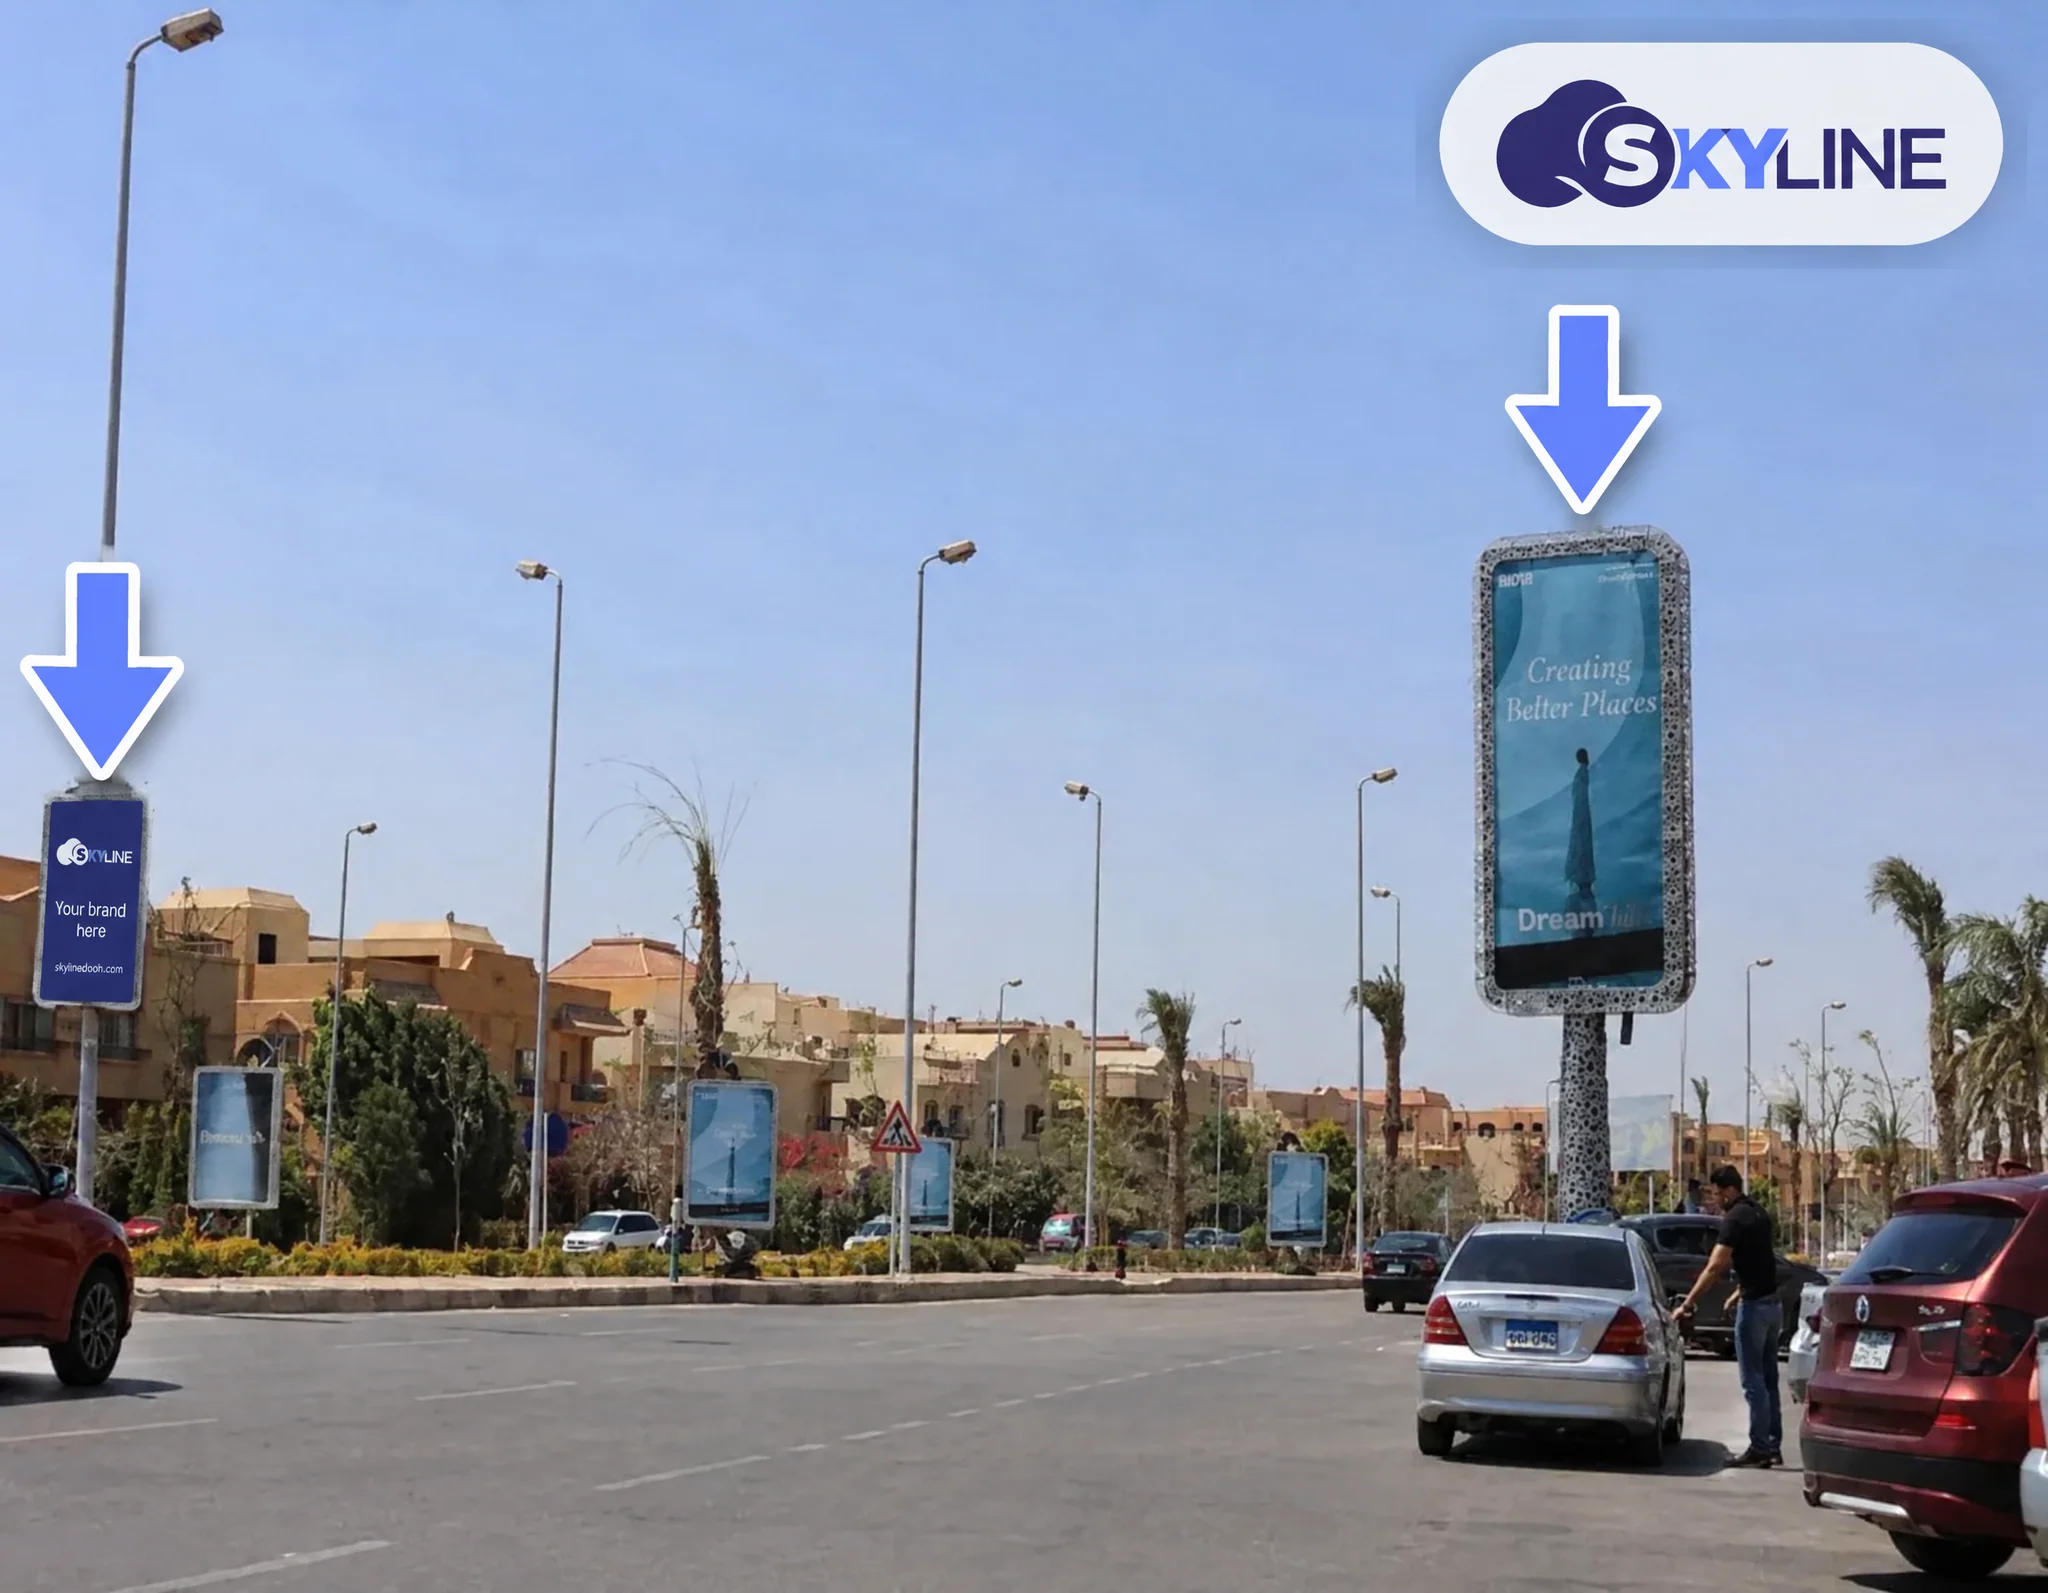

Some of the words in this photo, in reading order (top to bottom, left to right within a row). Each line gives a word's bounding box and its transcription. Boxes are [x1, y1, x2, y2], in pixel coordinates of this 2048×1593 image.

[1527, 654, 1633, 686] Creating
[1507, 694, 1574, 722] Better
[1580, 689, 1657, 718] Places
[76, 848, 133, 864] SKYLINE
[55, 900, 85, 917] Your
[88, 901, 126, 918] brand
[1517, 907, 1604, 932] Dream
[76, 923, 106, 938] here
[54, 962, 124, 975] skylinedooh.com
